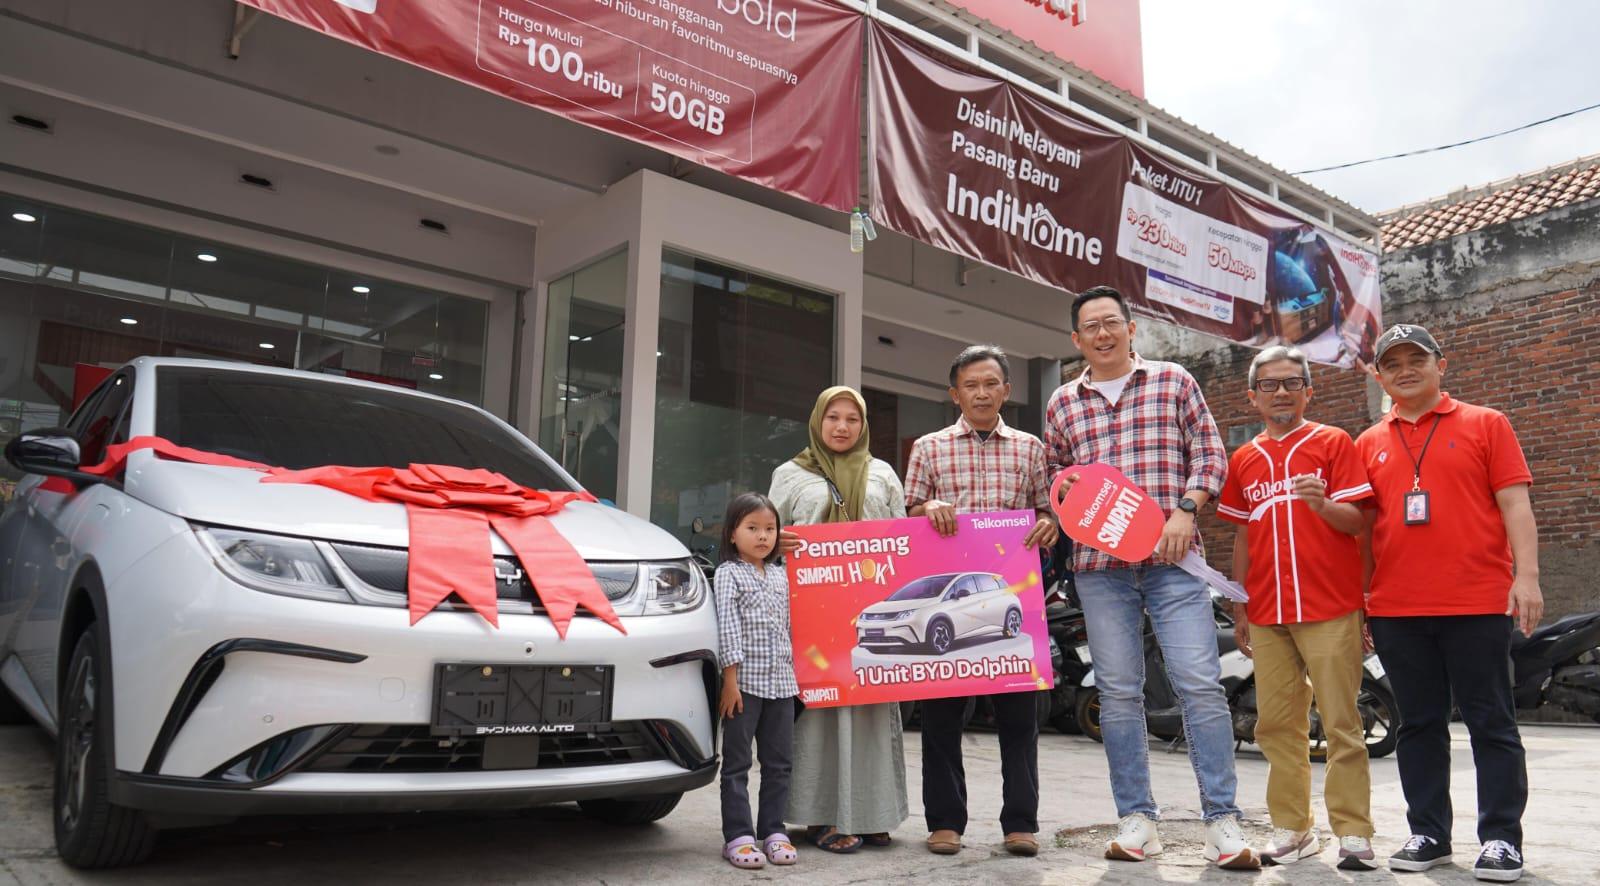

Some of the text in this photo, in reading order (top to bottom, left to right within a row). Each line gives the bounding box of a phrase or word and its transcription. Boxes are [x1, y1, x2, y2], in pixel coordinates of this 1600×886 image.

[498, 6, 583, 48] Harga Mulai
[658, 0, 724, 33] langganan
[615, 0, 799, 86] hiburan favoritmu sepuasnya
[652, 64, 731, 105] Kuota hingga
[651, 82, 726, 136] 50GB
[956, 97, 1081, 169] Disini Melayani
[951, 130, 1060, 193] Pasang Baru
[1131, 159, 1168, 191] Paket
[946, 173, 1103, 265] IndiHome
[971, 515, 1031, 530] Telkomsel
[1078, 478, 1114, 529] Telkomsel
[1096, 487, 1144, 549] SIMPATI
[793, 535, 910, 560] Pemenang
[796, 565, 844, 585] SIMPATI
[855, 655, 1032, 686] 1 Unit BYD Dolphin
[802, 688, 839, 703] SIMPATI
[505, 725, 537, 734] HAKA
[539, 724, 575, 733] AUTO
